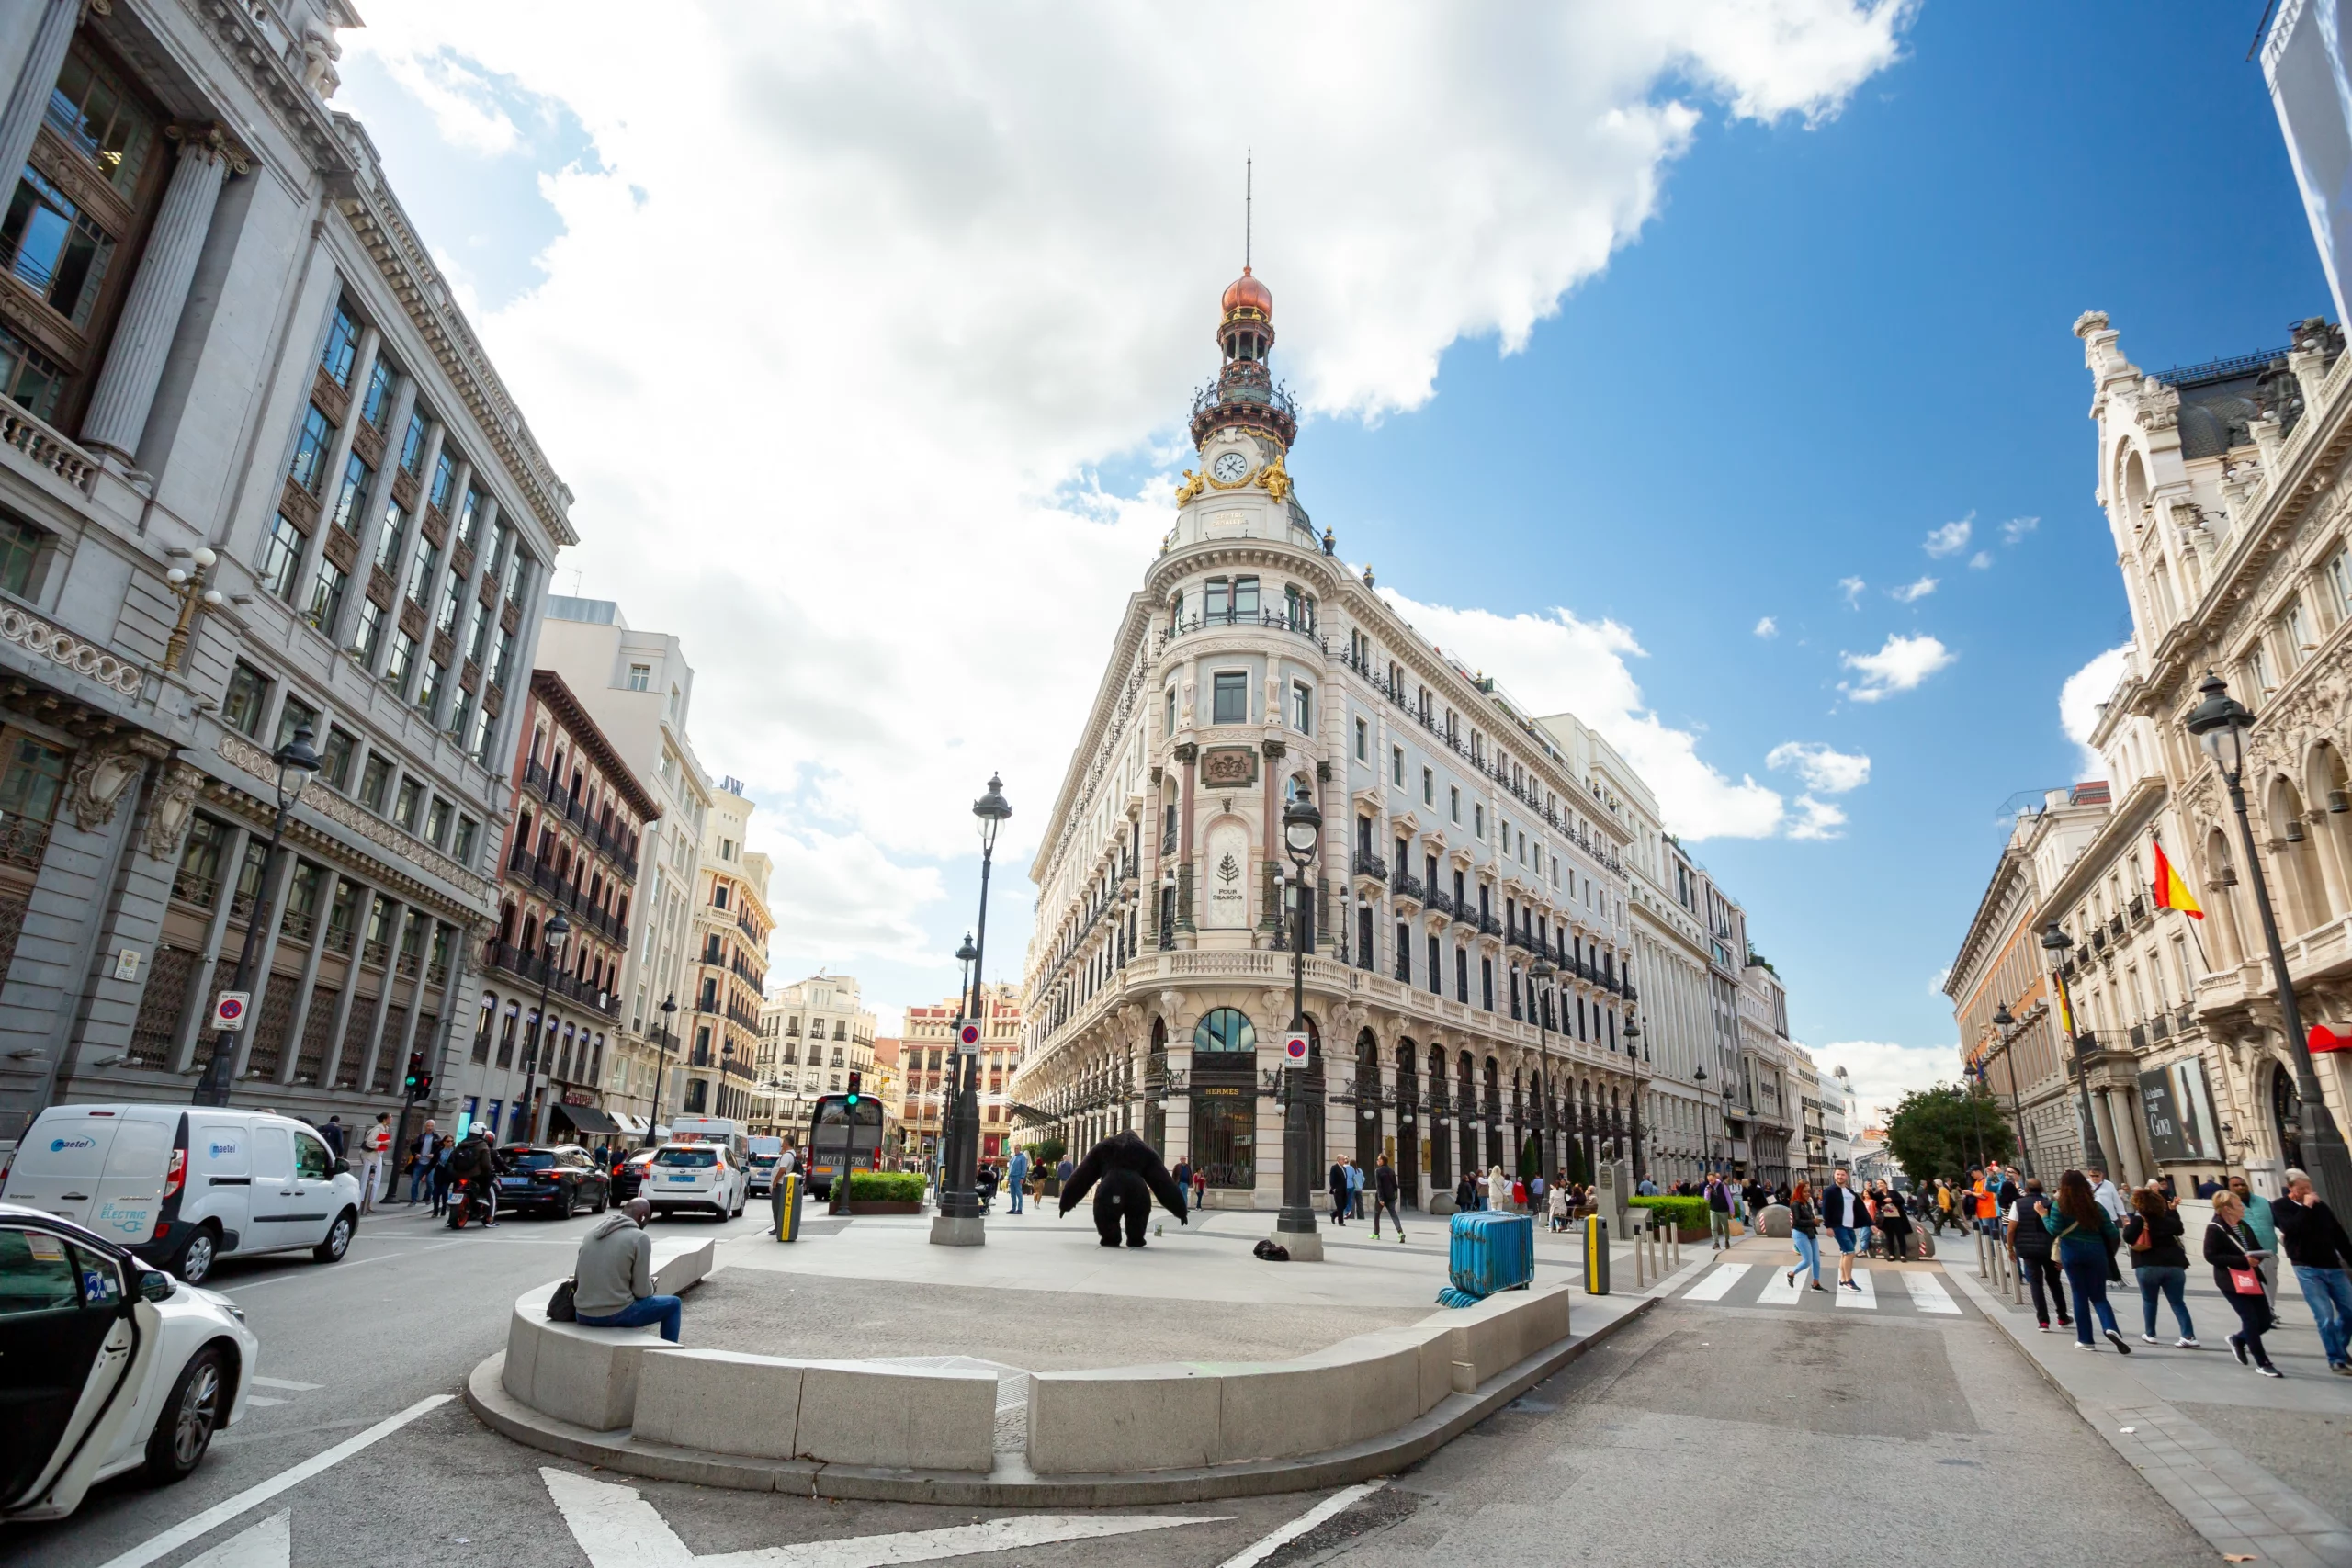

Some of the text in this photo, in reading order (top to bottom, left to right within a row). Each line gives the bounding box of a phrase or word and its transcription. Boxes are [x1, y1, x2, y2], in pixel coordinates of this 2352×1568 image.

[719, 775, 745, 796] JW
[55, 1140, 90, 1148] maetel
[212, 1144, 236, 1154] maetel
[820, 1156, 867, 1167] MOLIERO
[100, 1210, 147, 1219] ELECTRIC
